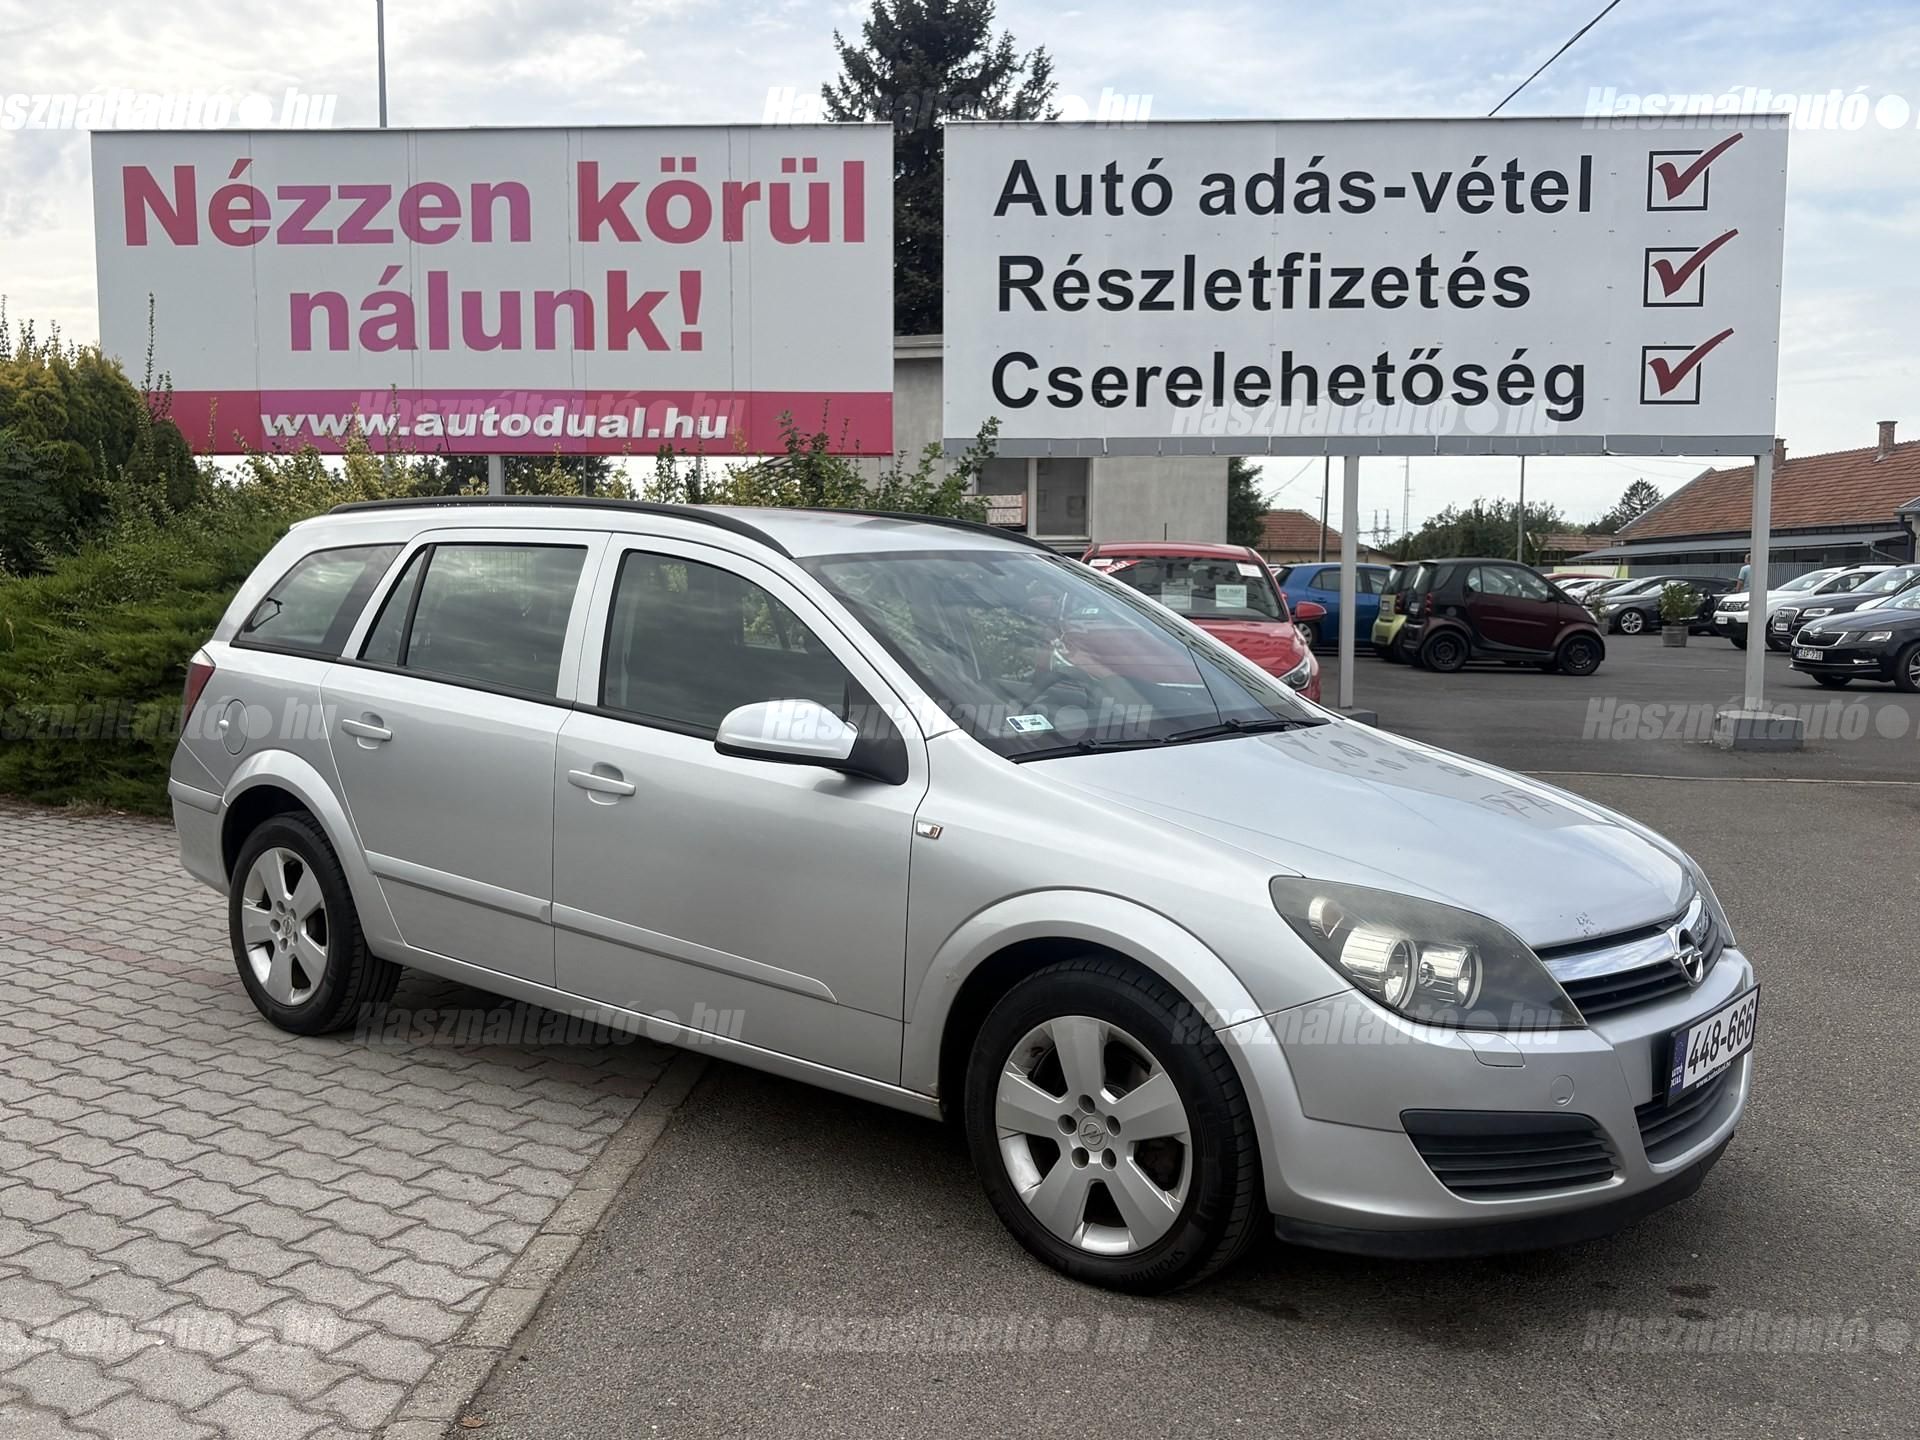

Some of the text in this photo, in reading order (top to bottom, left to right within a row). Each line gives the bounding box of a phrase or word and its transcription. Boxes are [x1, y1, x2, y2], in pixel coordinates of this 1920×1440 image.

[122, 156, 867, 247] Nézzen körül
[993, 154, 1593, 218] Autó adás-vétel
[289, 264, 704, 353] nálunk!
[996, 248, 1532, 313] Részletfizetés
[260, 404, 729, 441] www.autodual.hu
[991, 345, 1586, 423] Cserelehetőség
[1687, 998, 1754, 1075] 448-666
